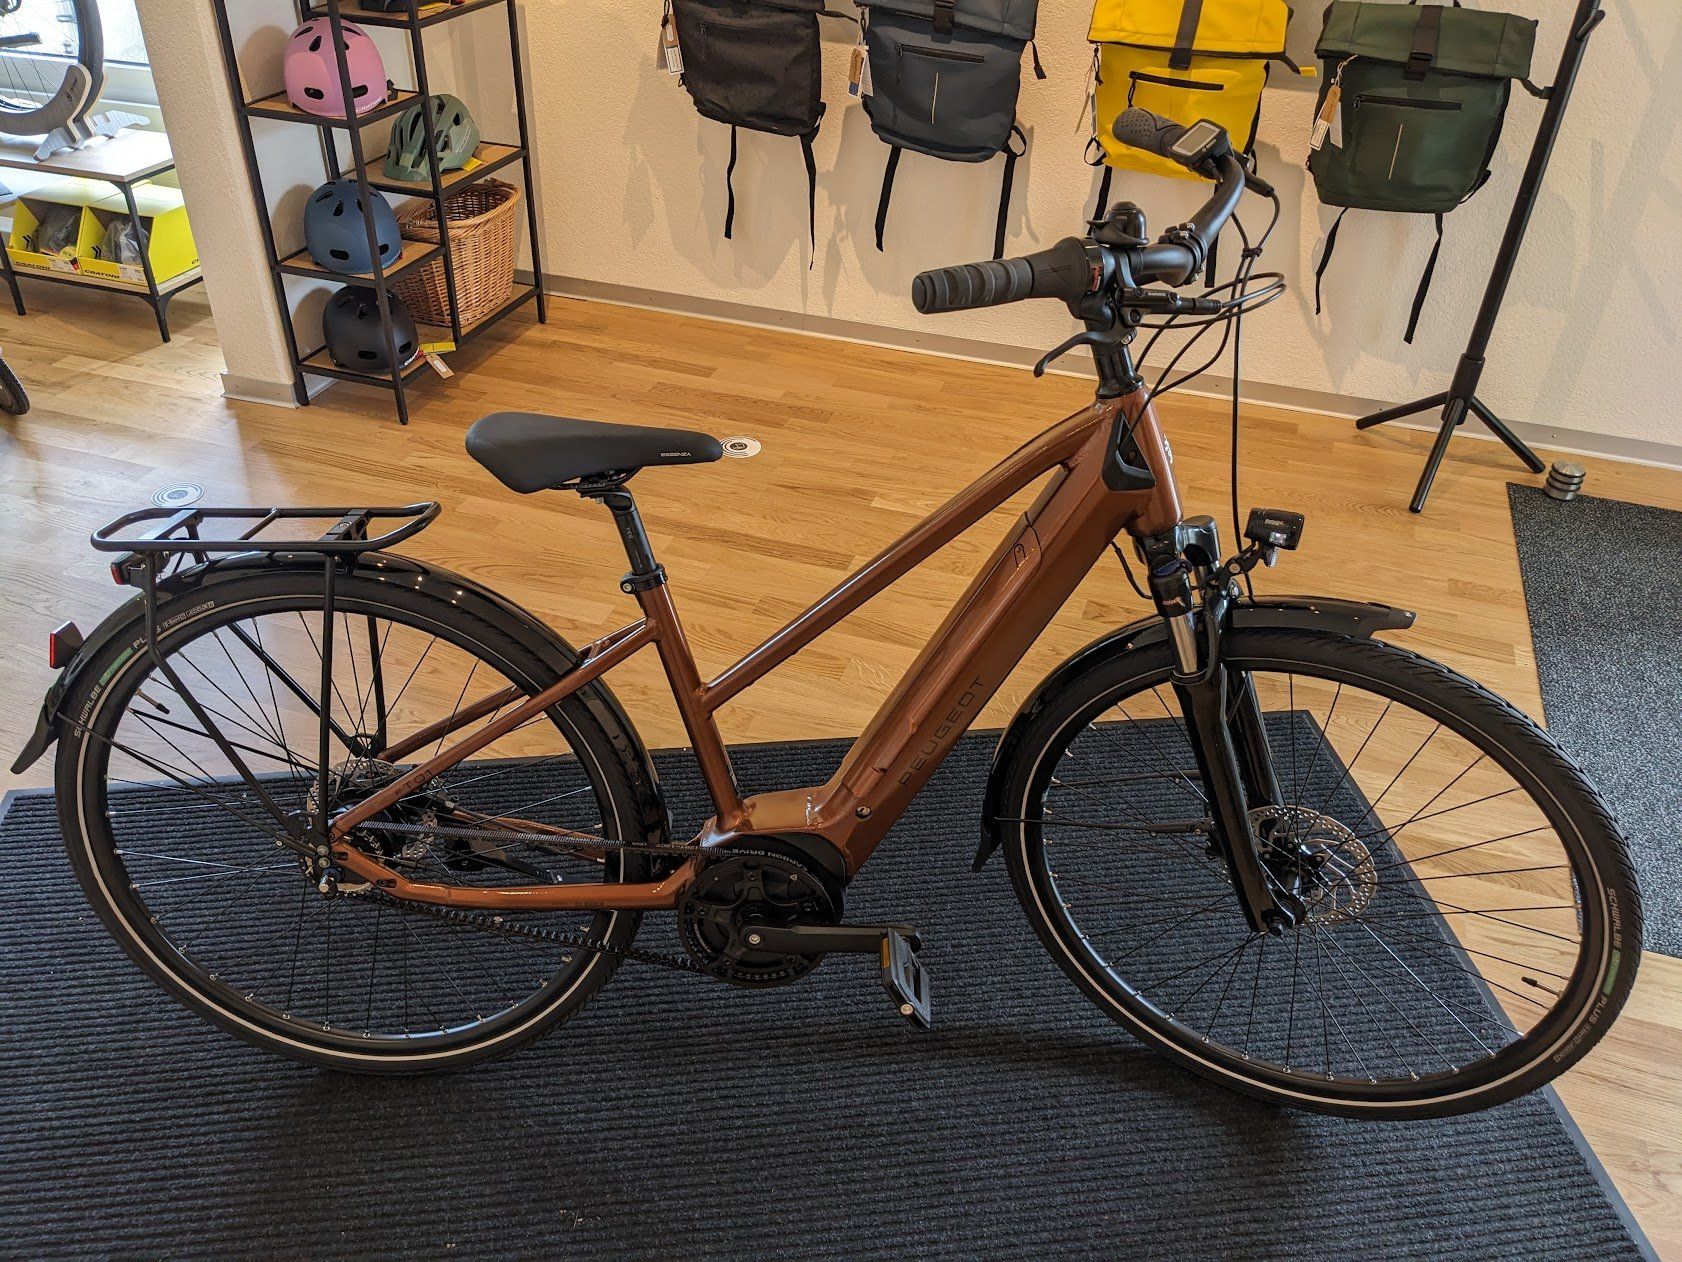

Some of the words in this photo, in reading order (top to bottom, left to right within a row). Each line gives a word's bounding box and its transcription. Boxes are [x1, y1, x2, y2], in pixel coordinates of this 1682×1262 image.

[84, 269, 120, 279] CRATONI
[133, 625, 161, 649] PLS
[898, 676, 984, 786] PEUGEOT
[767, 851, 808, 873] CARBON
[1606, 887, 1622, 949] SCHWALBE
[1589, 995, 1608, 1025] PLUS
